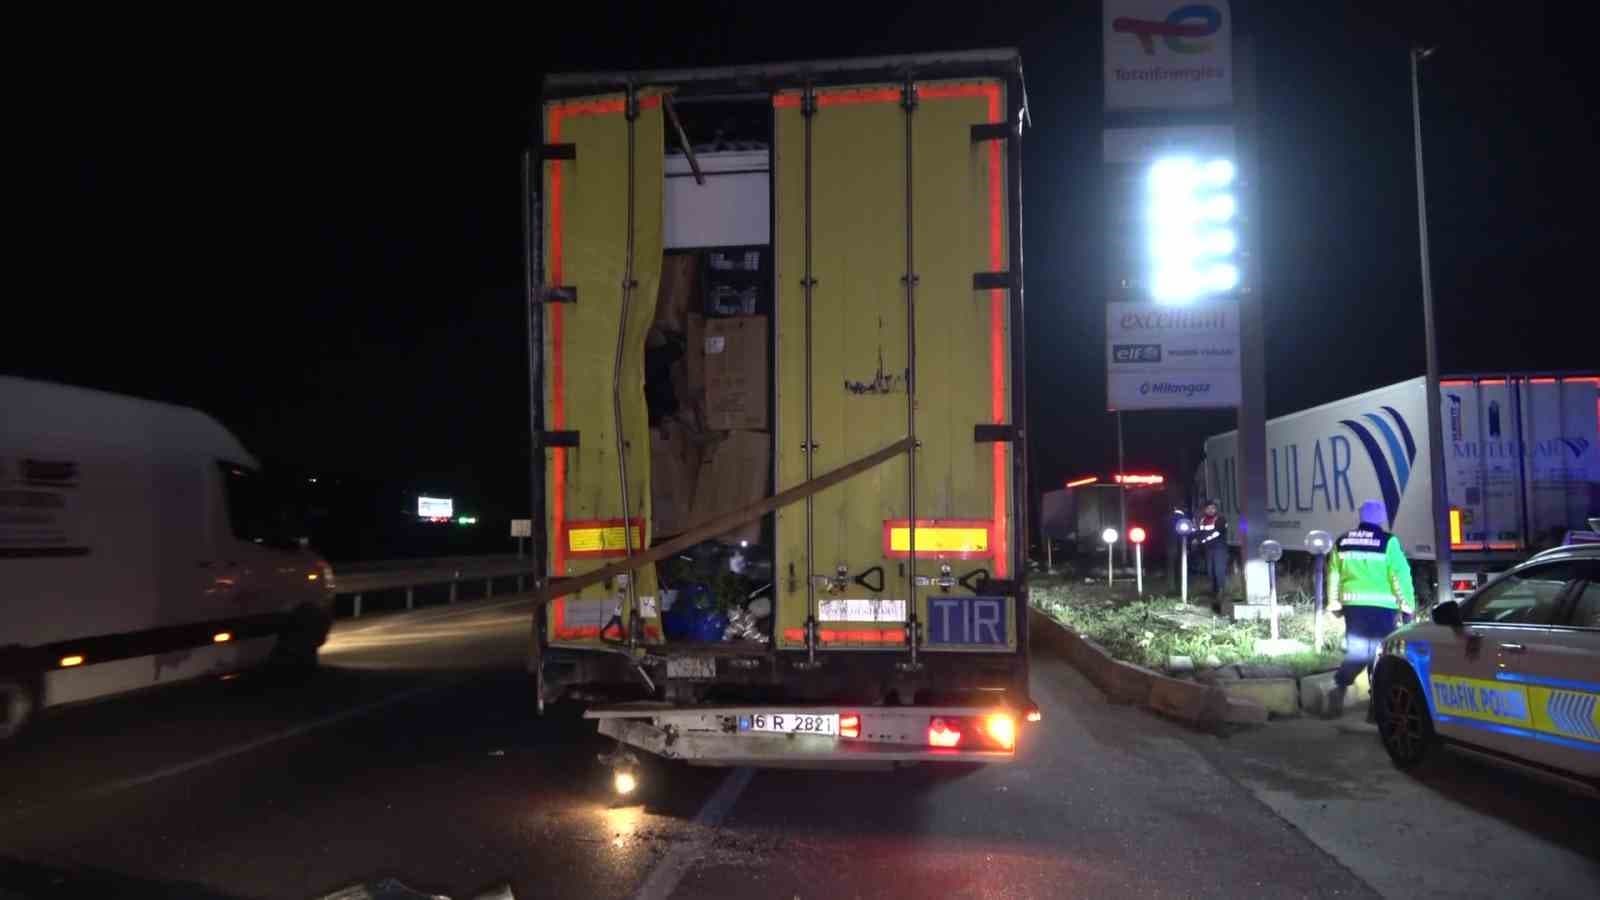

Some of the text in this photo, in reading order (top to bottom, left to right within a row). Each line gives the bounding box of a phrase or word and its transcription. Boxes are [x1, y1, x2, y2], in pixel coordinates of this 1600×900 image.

[933, 601, 1000, 642] TIR
[750, 715, 765, 729] 16
[773, 716, 784, 730] R
